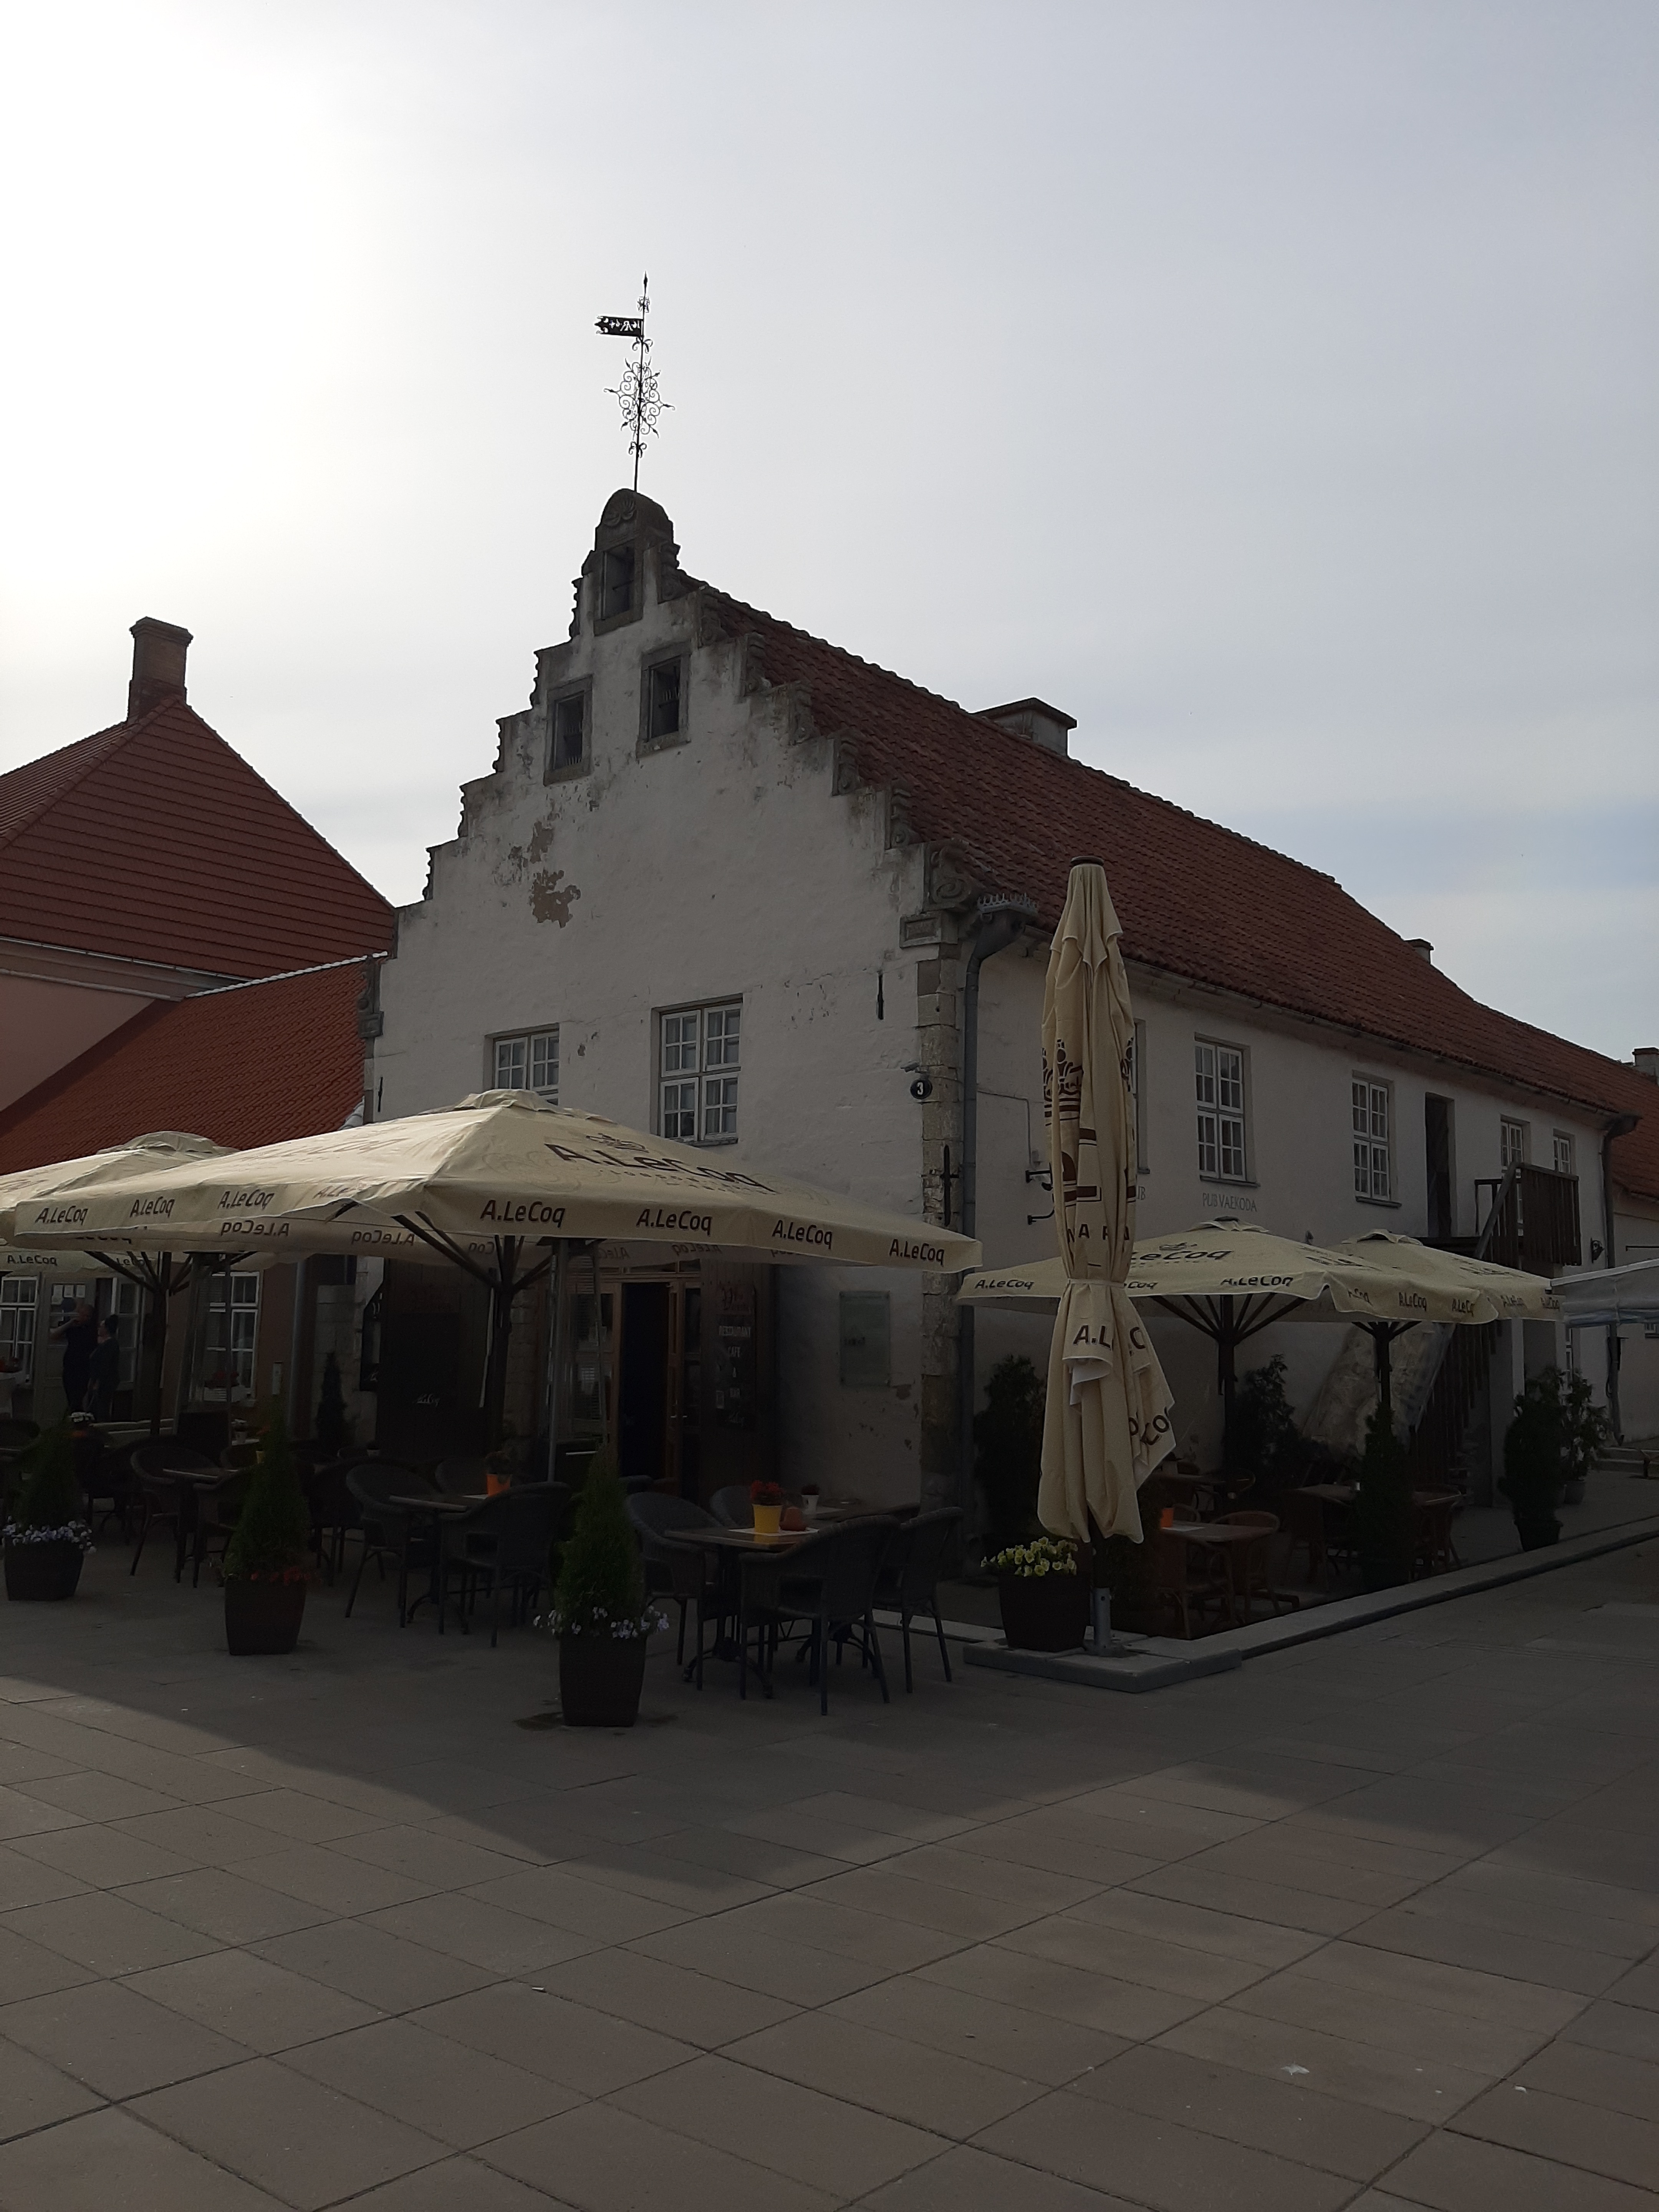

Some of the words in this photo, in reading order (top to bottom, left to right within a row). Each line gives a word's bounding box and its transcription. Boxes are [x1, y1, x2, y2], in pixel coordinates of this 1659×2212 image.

[917, 1082, 924, 1095] 3
[544, 1143, 781, 1195] A.LeCoq
[130, 1197, 175, 1218] A.LeCoq
[218, 1189, 275, 1210] A.LeCoq
[1202, 1193, 1218, 1207] PUB
[1219, 1194, 1257, 1212] VAEKODA
[35, 1205, 88, 1225] A.LeCoq
[480, 1199, 566, 1227] A.LeCoq
[636, 1209, 712, 1235] A.LeCoq
[772, 1220, 832, 1249] A.LeCoq
[8, 1255, 58, 1266] A.LeCoq
[889, 1238, 944, 1265] A.LeCoq
[975, 1279, 1034, 1290] A.LeCoq
